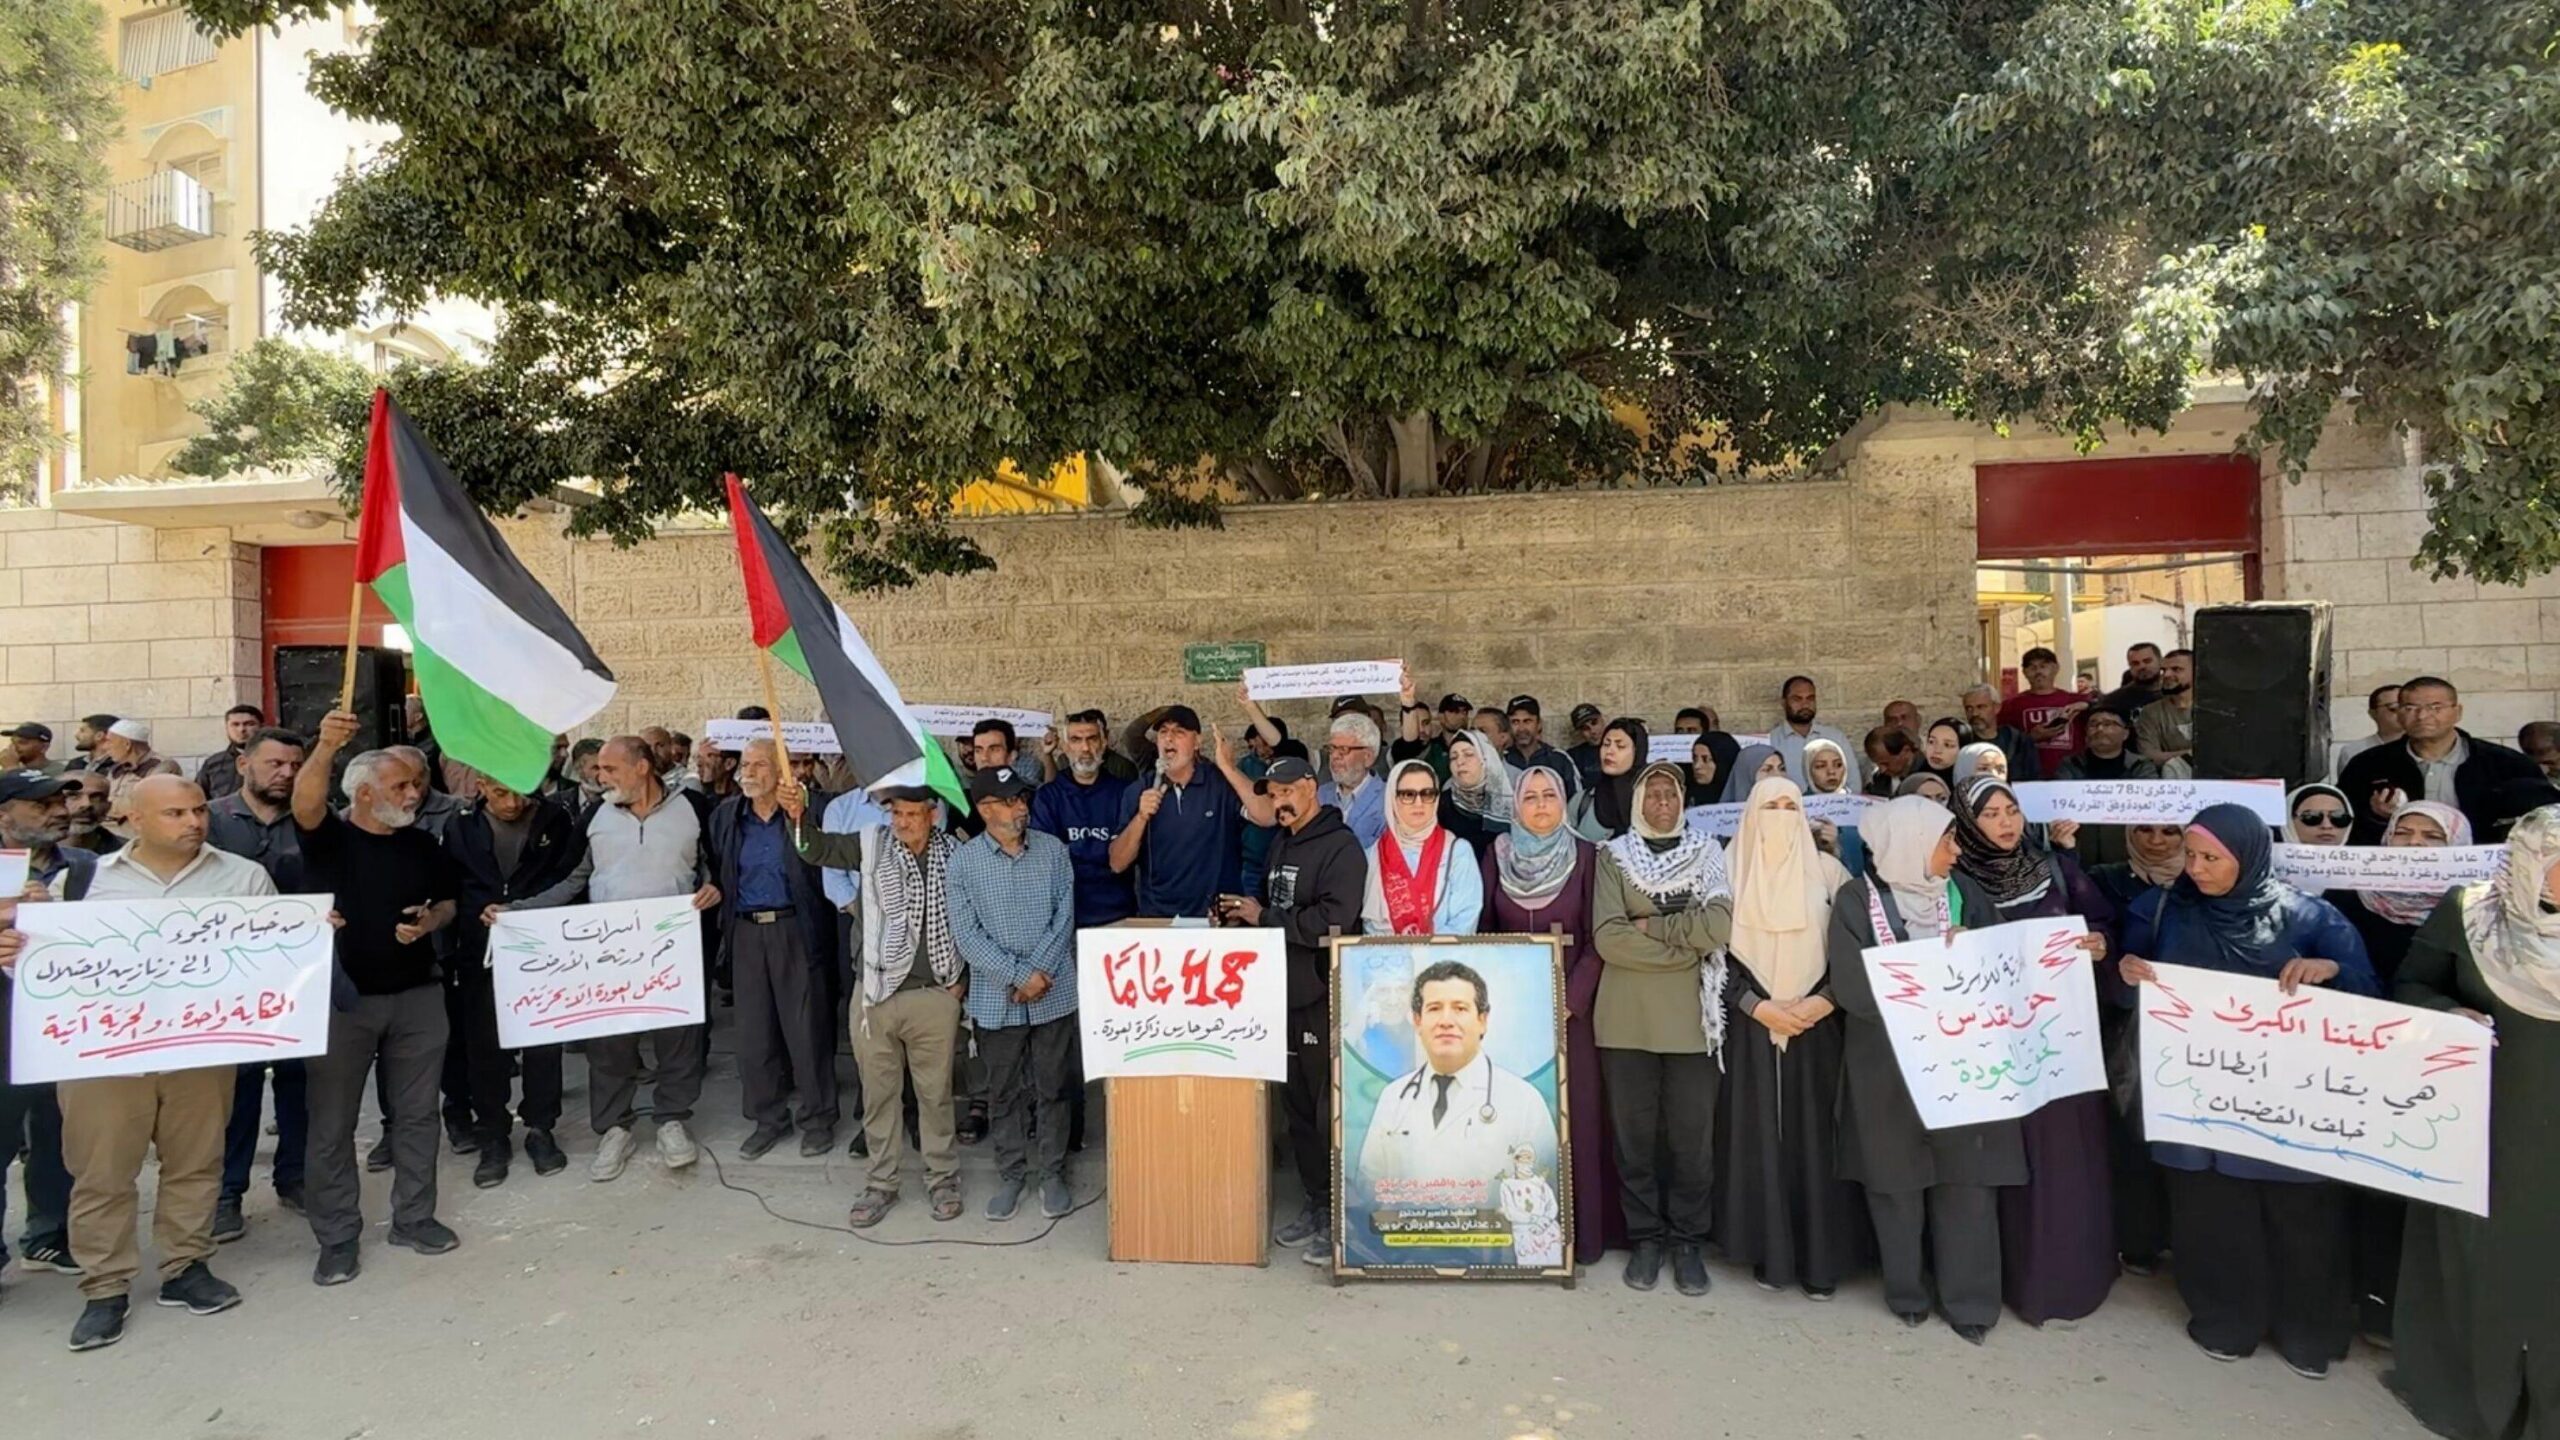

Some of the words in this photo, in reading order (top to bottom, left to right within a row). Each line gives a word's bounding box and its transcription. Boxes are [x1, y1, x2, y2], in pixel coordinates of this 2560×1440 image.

[2050, 799, 2077, 810] 194
[2145, 784, 2182, 798] الذكرى
[1067, 826, 1109, 841] BOSS
[229, 911, 280, 941] خيام
[651, 938, 676, 968] هم
[2212, 995, 2314, 1038] الكبرى
[2322, 1017, 2413, 1056] نكبتنا
[2185, 1043, 2269, 1084] أبطالنا
[2294, 1066, 2369, 1105] بقاء
[2382, 1084, 2438, 1116] هي
[2207, 1094, 2304, 1128] القضبان
